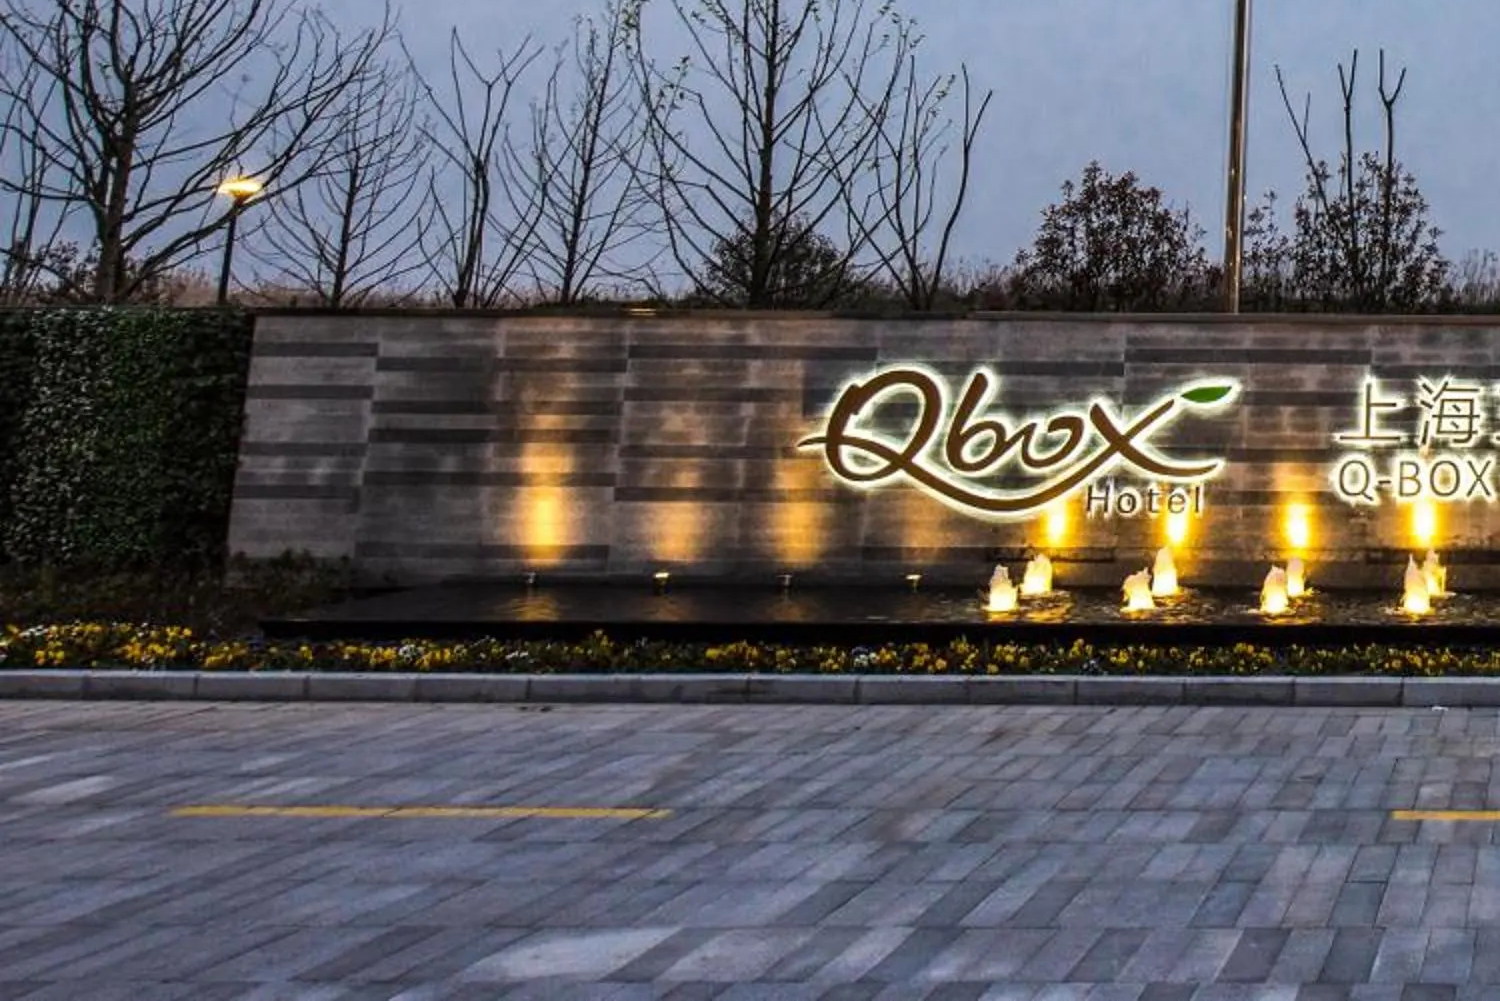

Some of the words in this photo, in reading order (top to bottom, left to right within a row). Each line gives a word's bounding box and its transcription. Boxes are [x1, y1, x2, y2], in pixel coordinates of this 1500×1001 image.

[798, 369, 1220, 512] Qbox
[1086, 484, 1204, 514] Hotel
[1338, 459, 1494, 502] Q-BOX
